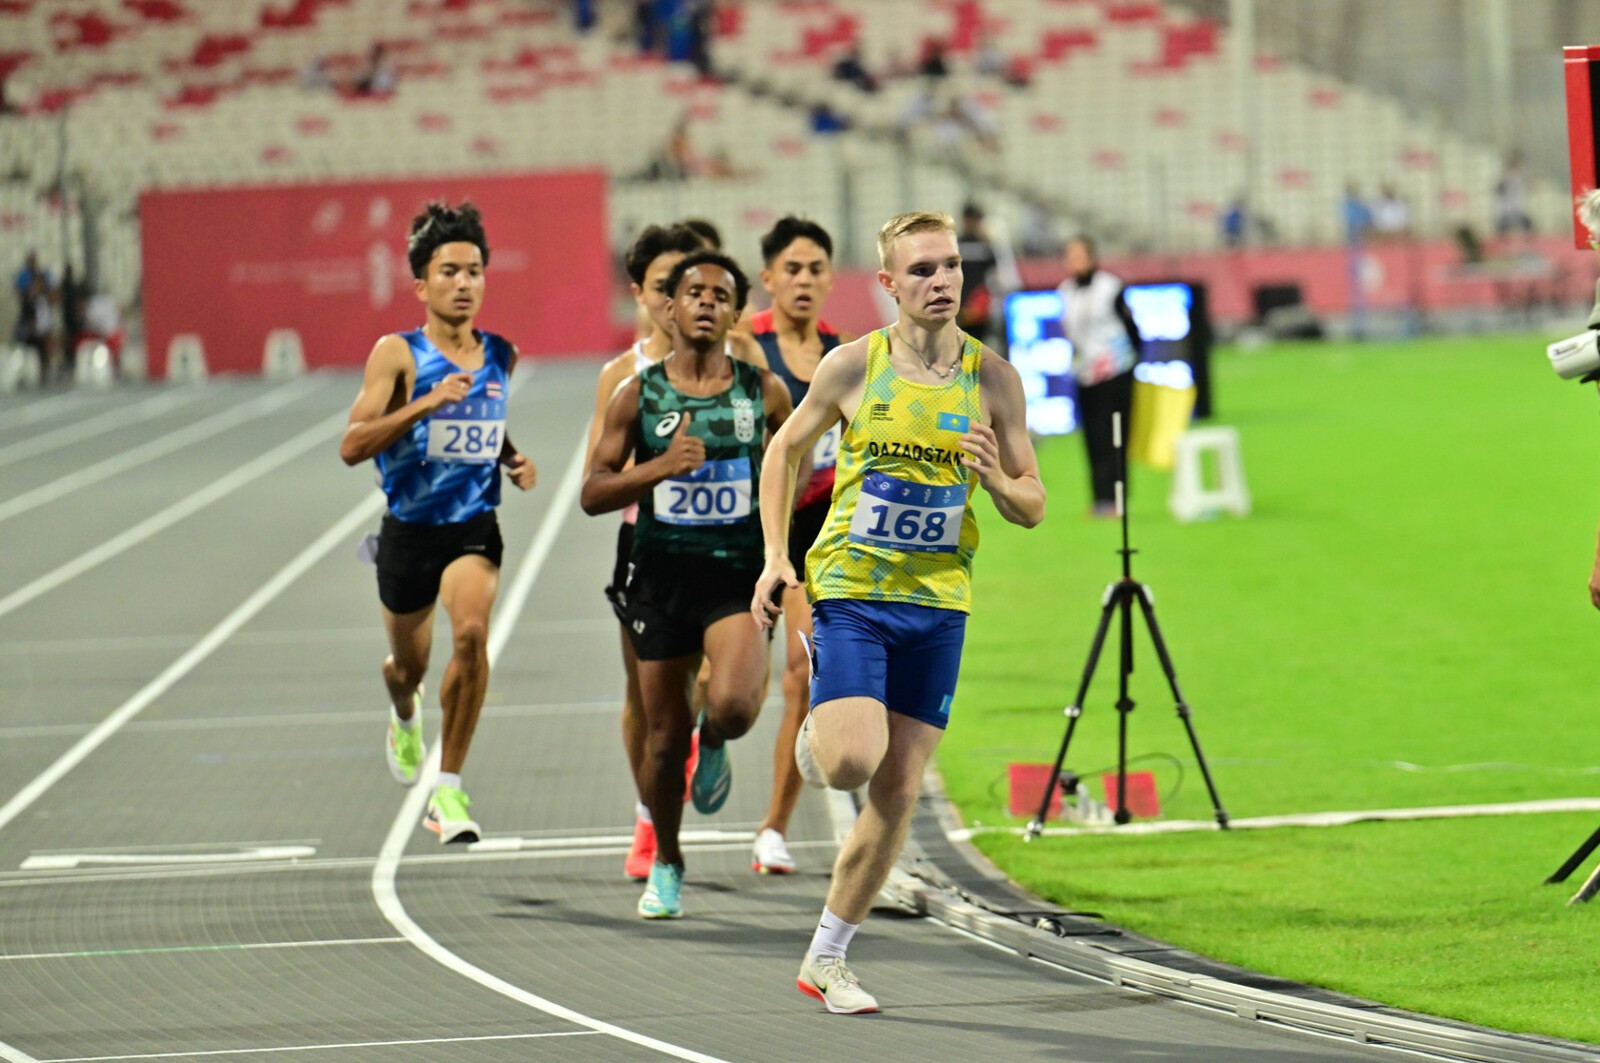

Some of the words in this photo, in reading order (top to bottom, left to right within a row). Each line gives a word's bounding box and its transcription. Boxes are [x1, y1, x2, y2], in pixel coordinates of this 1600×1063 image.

[443, 425, 498, 453] 284
[823, 430, 835, 458] 2
[868, 441, 965, 466] QAZAQSTAN
[669, 486, 737, 516] 200
[866, 504, 947, 543] 168
